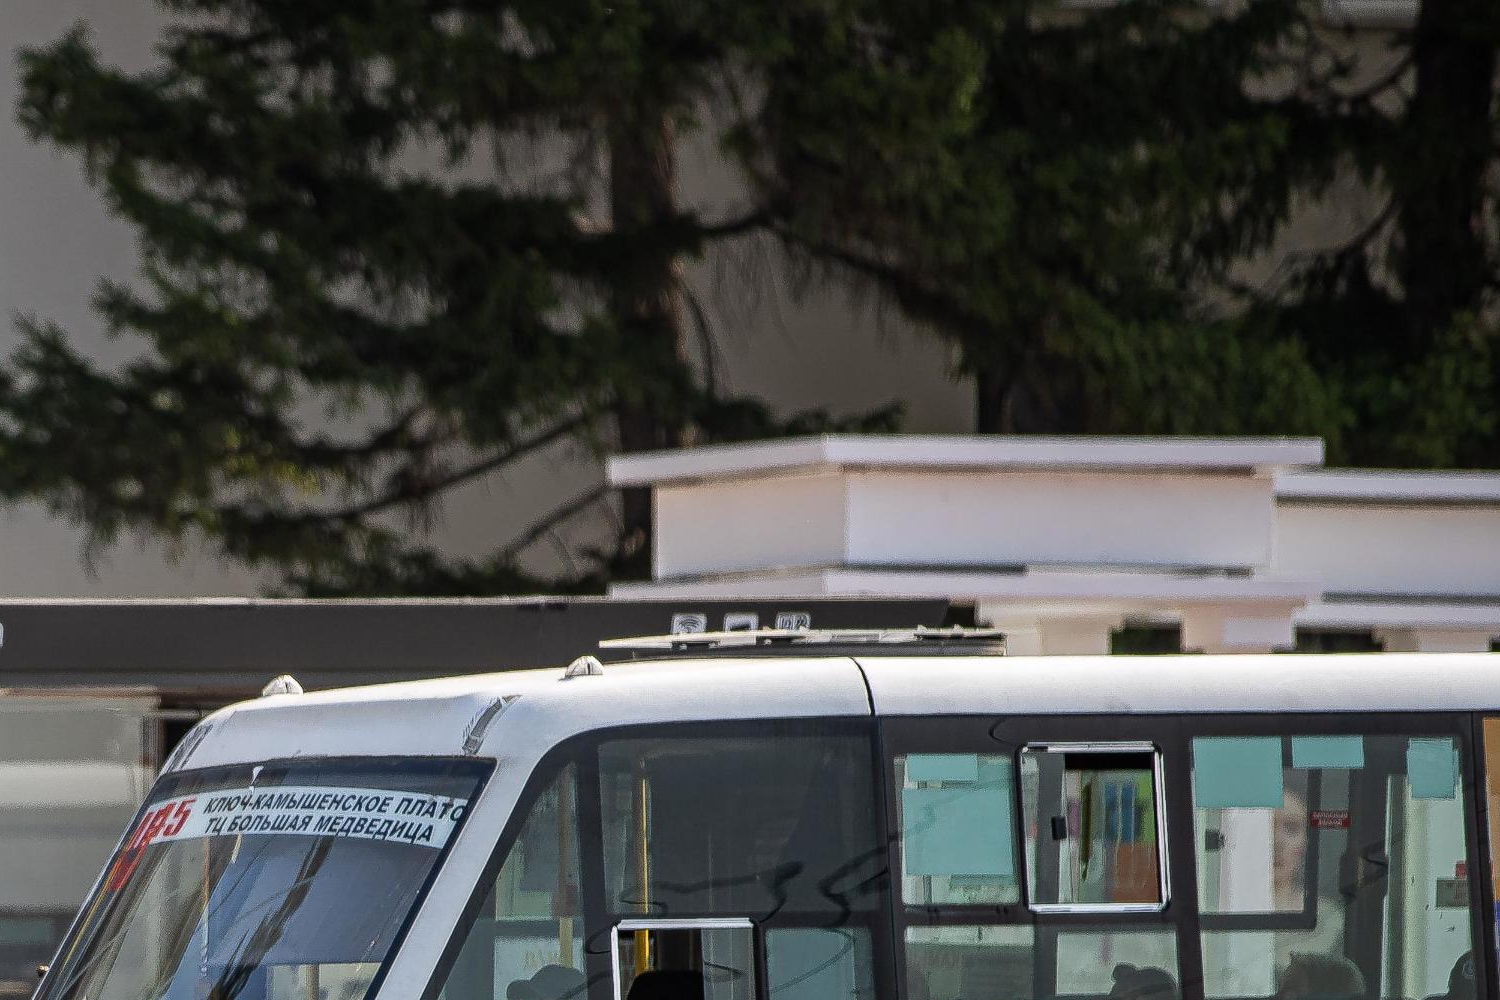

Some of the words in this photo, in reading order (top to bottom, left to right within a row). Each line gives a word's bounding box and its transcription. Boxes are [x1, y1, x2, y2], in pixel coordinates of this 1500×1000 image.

[203, 792, 391, 815] КЛЮЧ-КАМЫШЕНСКОЕ
[204, 816, 226, 837] ТЦ
[223, 814, 312, 833] БОЛЬШАЯ
[312, 815, 434, 845] МЕДВЕДИЦА
